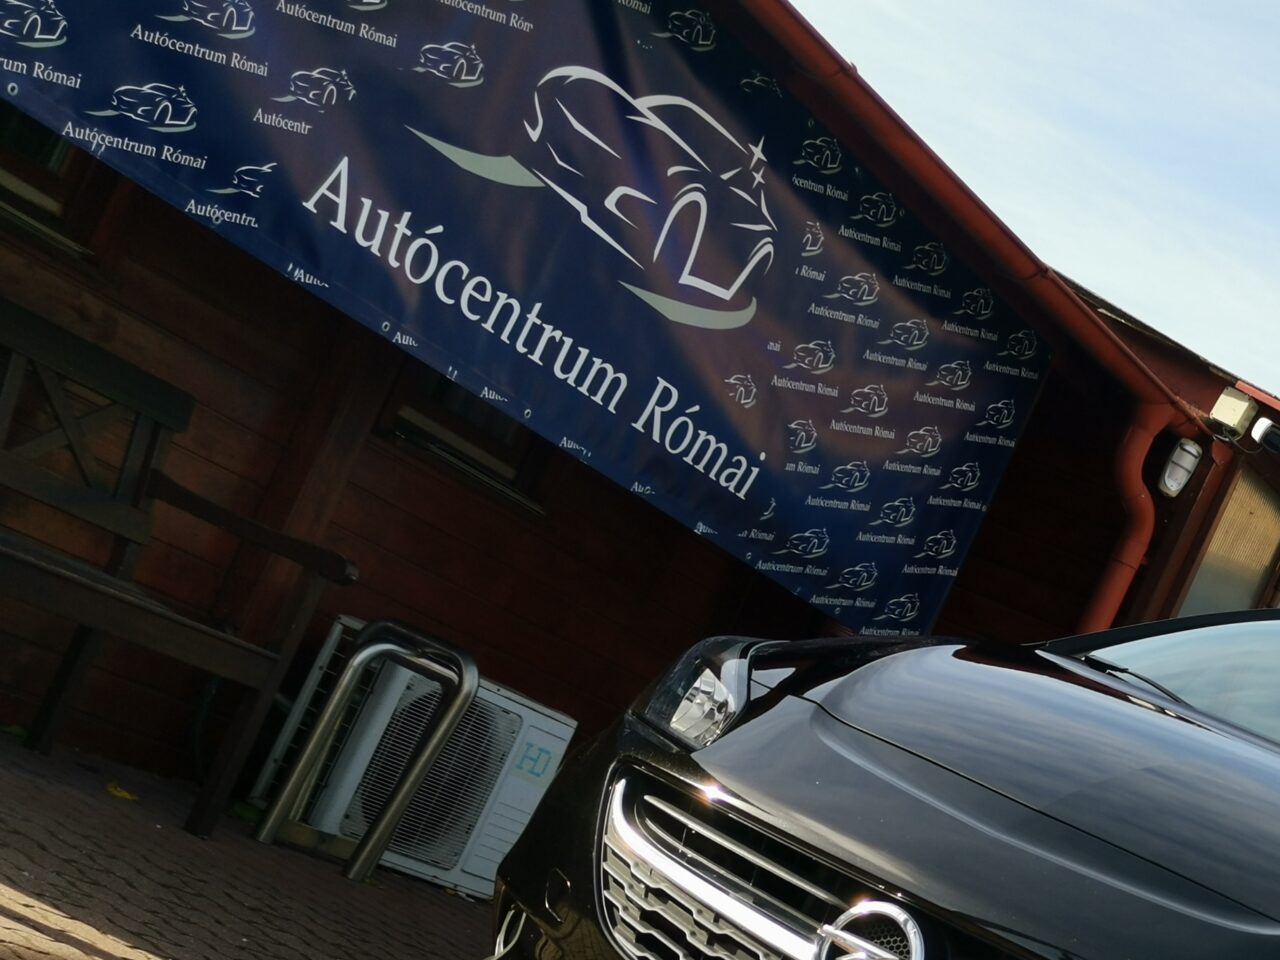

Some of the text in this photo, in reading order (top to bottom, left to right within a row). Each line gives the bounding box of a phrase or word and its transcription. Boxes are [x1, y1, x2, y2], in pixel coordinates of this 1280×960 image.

[275, 0, 399, 48] Autócentrum Római
[32, 61, 83, 90] Római
[130, 23, 269, 78] Autócentrum Római
[61, 120, 209, 171] Autócentrum Római
[302, 156, 767, 501] Autócentrum Római
